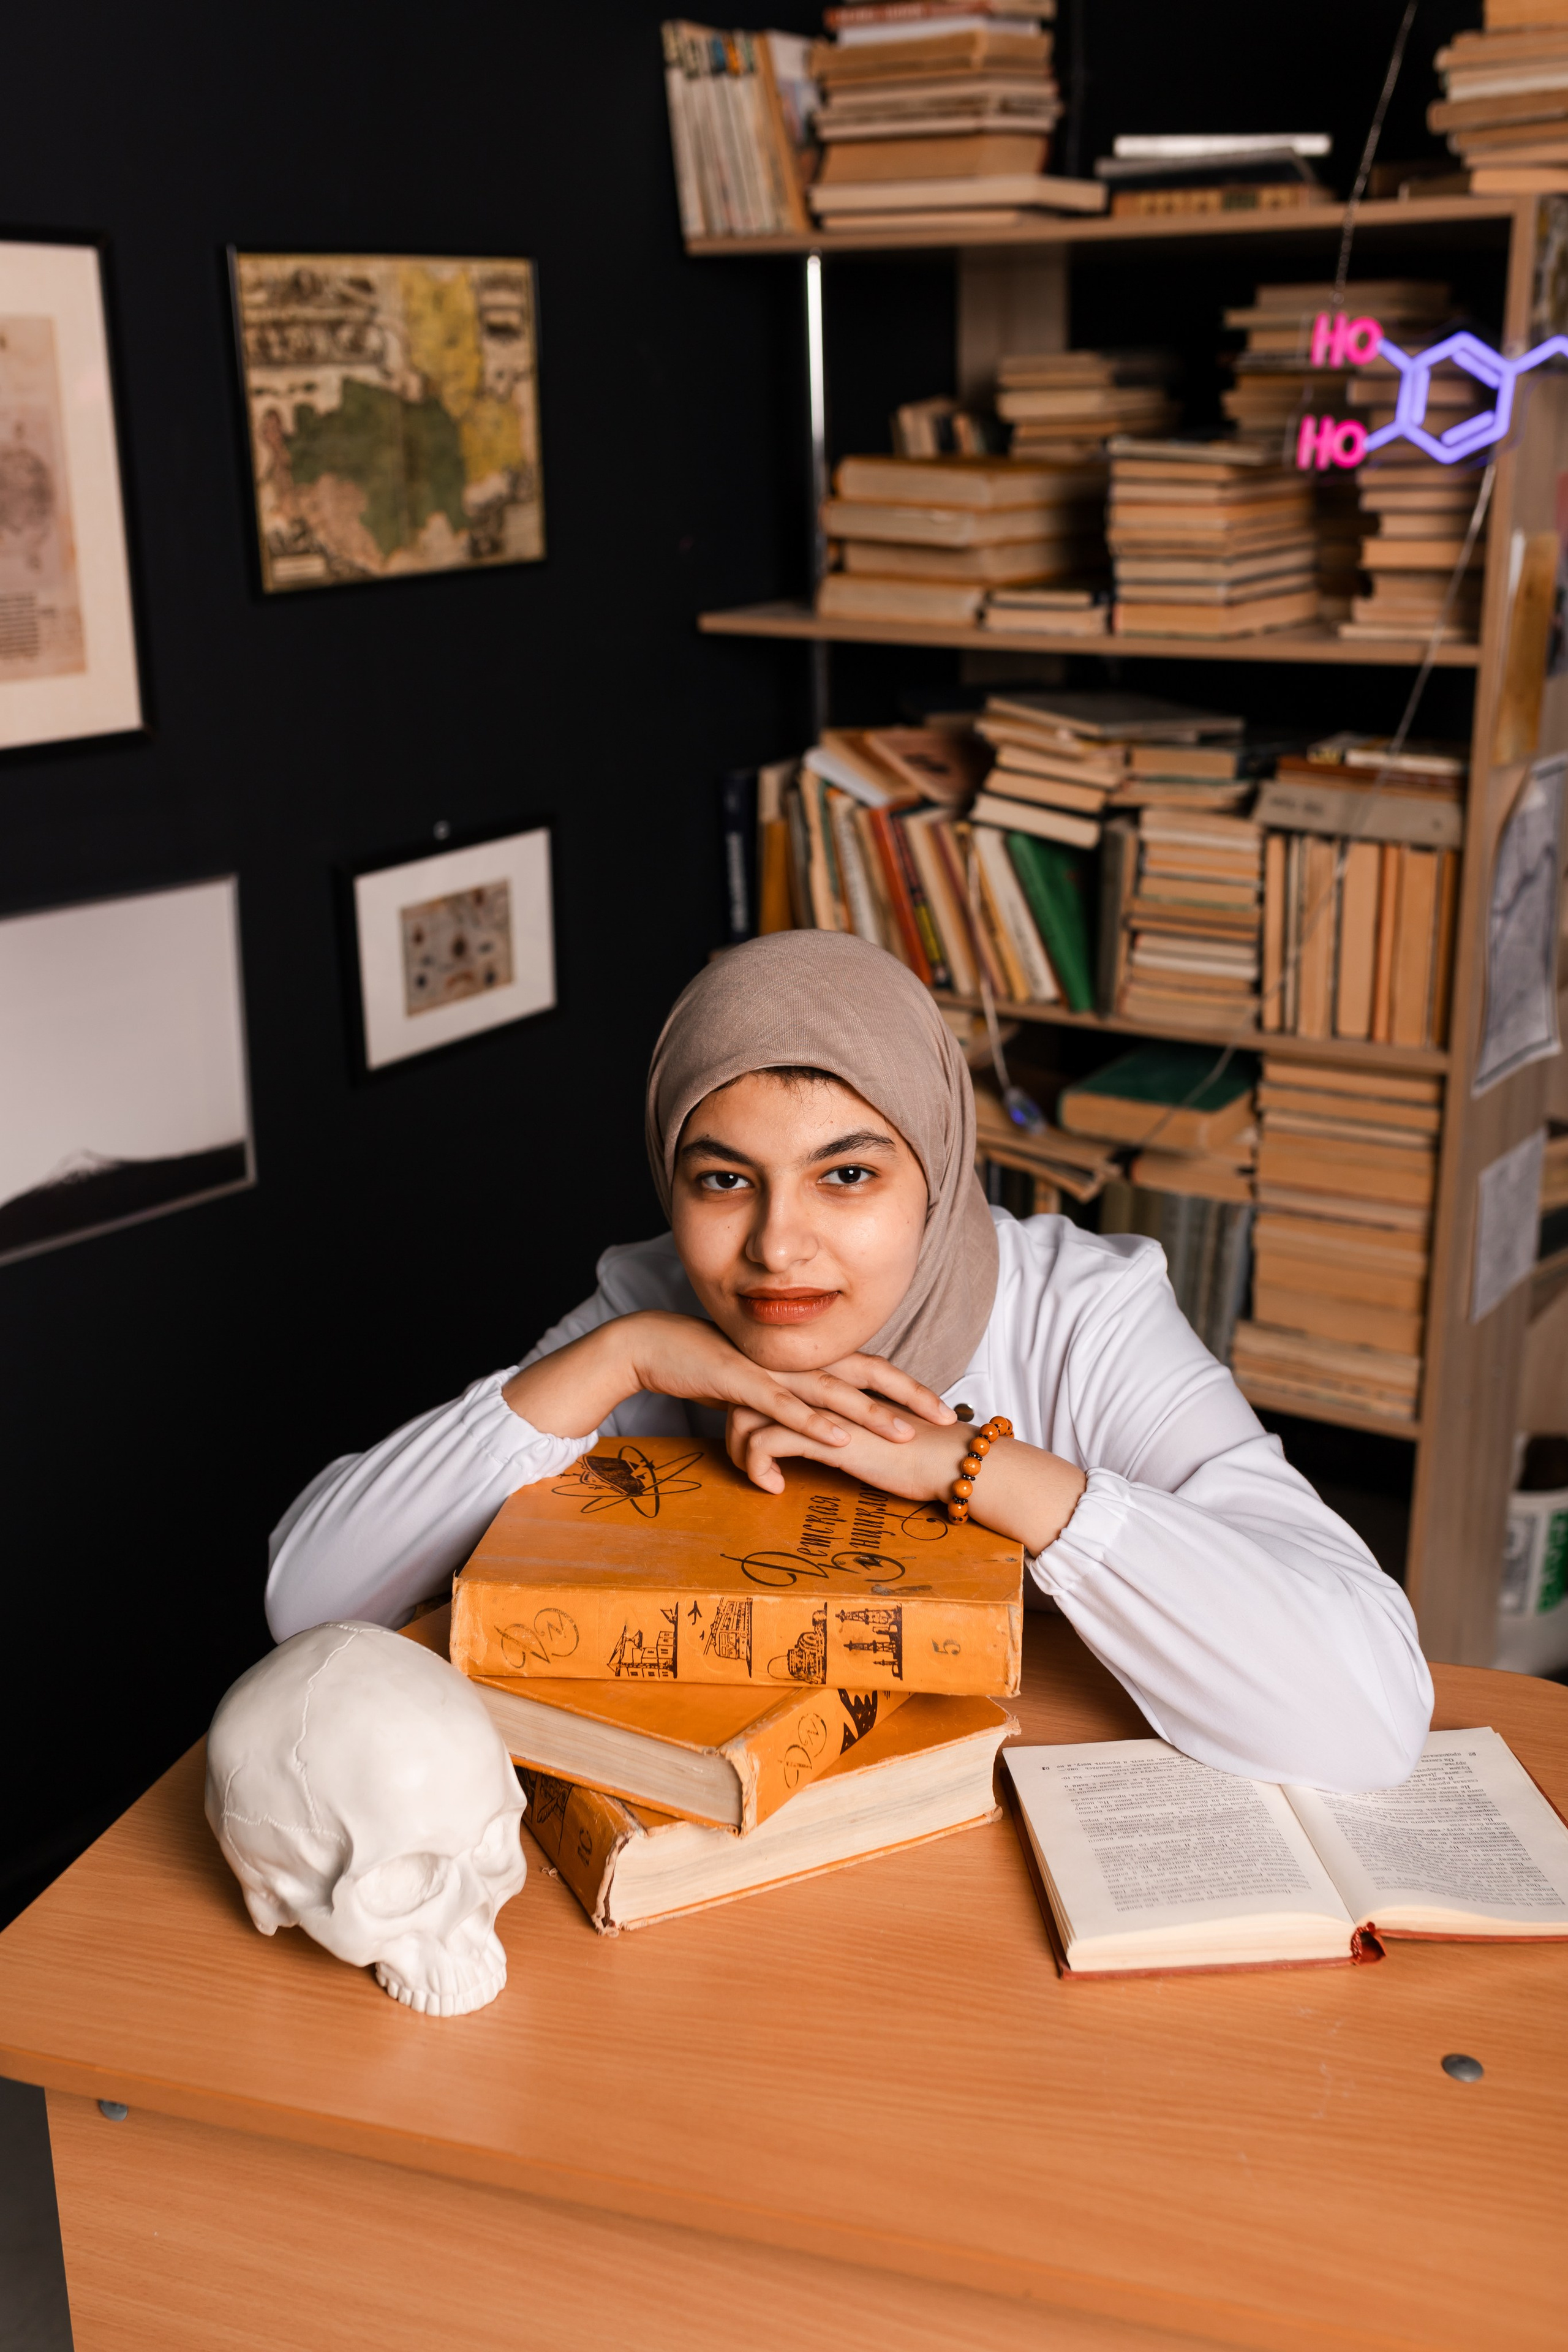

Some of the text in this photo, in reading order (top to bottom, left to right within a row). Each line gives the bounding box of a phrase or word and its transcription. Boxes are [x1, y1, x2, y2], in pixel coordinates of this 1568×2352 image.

[1310, 311, 1384, 369] HO
[1296, 413, 1368, 471] HO
[720, 1495, 848, 1587] Детская
[931, 1638, 961, 1656] 5
